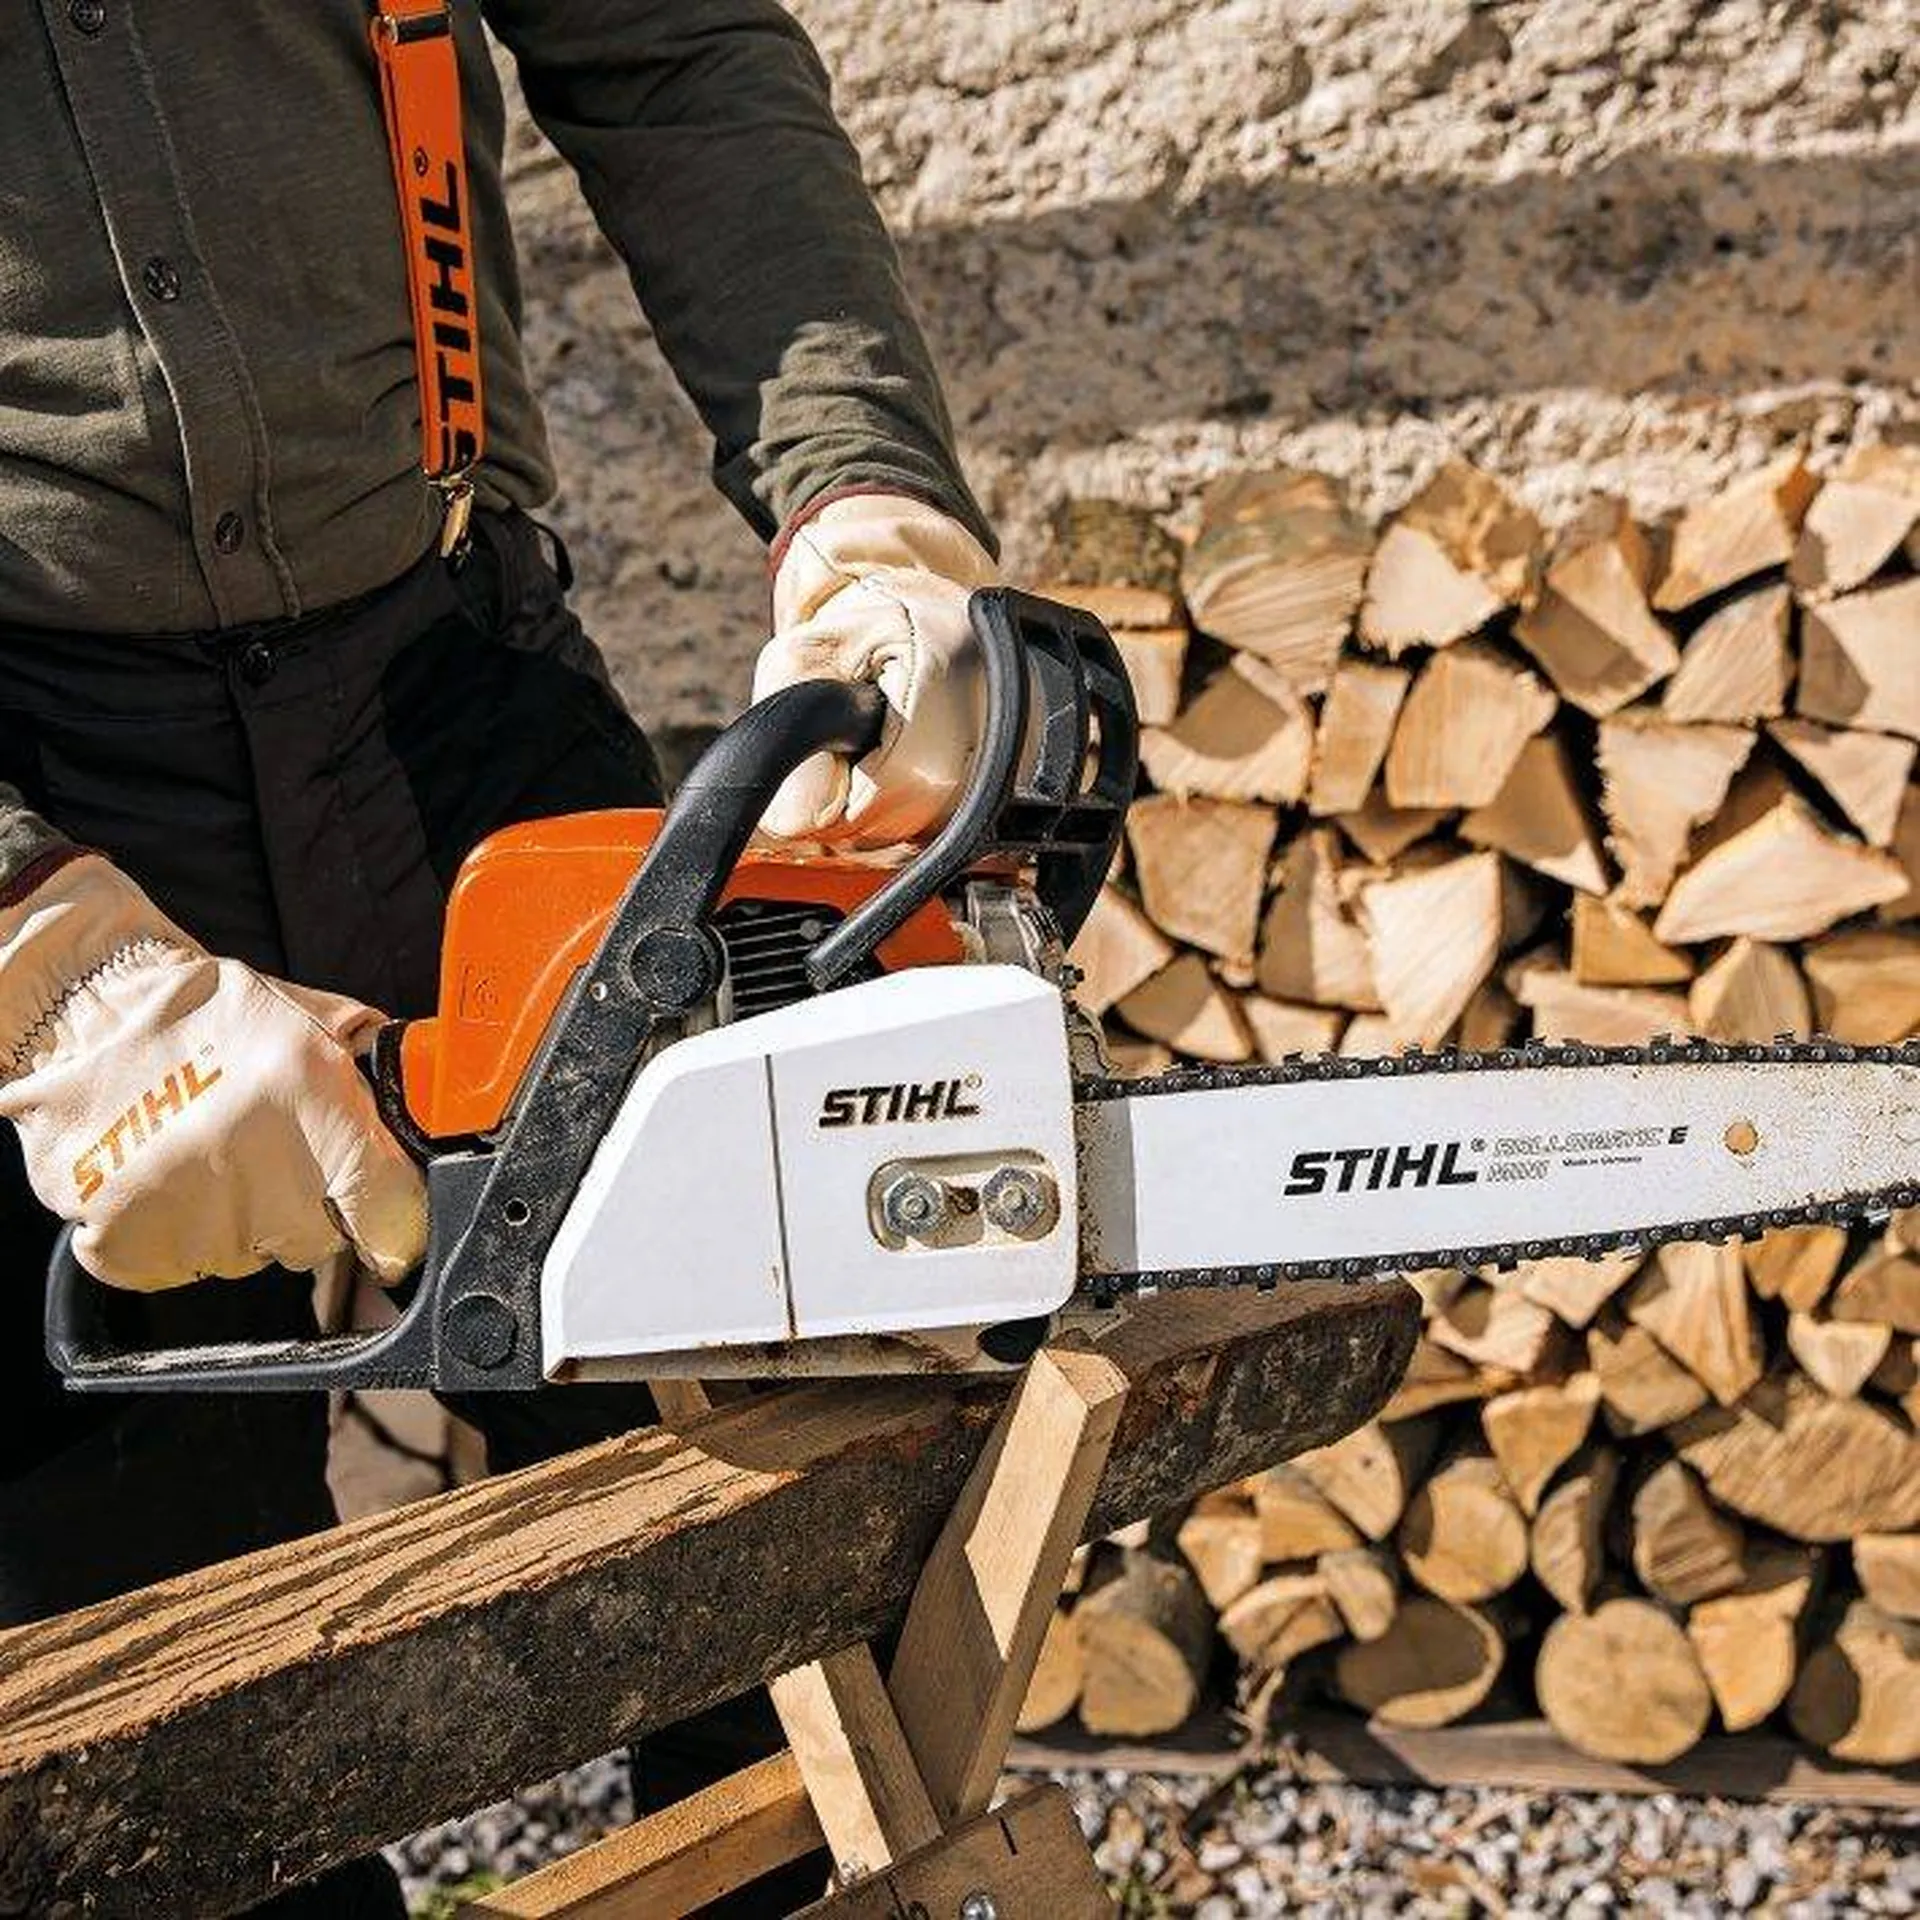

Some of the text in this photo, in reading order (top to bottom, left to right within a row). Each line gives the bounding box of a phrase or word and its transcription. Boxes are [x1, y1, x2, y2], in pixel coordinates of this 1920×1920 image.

[73, 1061, 222, 1203] STIHL
[819, 1079, 980, 1128] STIHL
[1284, 1142, 1478, 1196] STIHL
[1668, 1126, 1689, 1145] E
